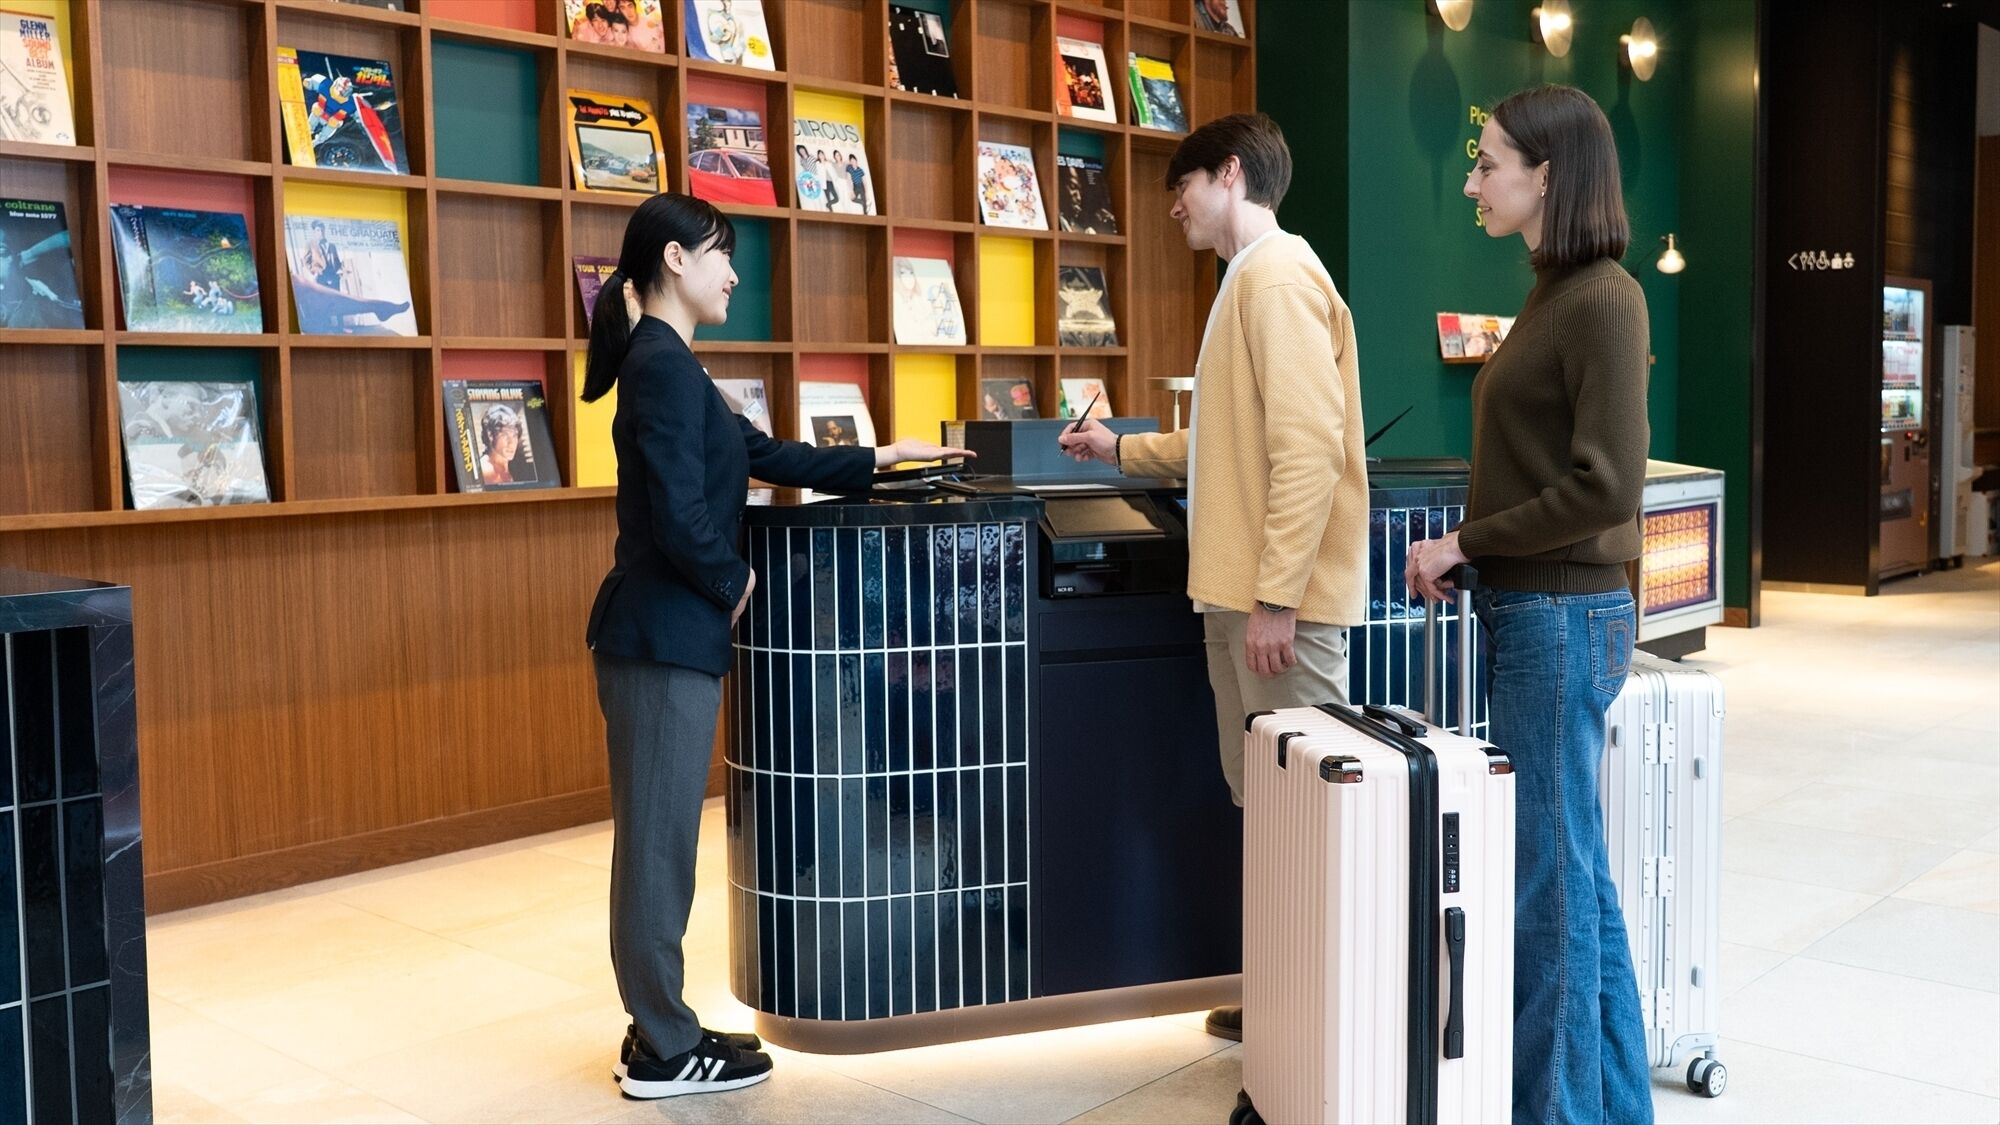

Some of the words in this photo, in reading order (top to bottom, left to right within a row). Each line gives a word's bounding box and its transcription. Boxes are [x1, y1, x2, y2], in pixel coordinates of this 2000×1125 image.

[20, 19, 47, 32] GLENN
[19, 28, 51, 40] MILLER
[26, 57, 55, 70] ALBUM
[1469, 105, 1490, 127] Pla
[4, 200, 56, 211] coltrane
[330, 227, 349, 237] THE
[350, 228, 398, 240] GRADUATE
